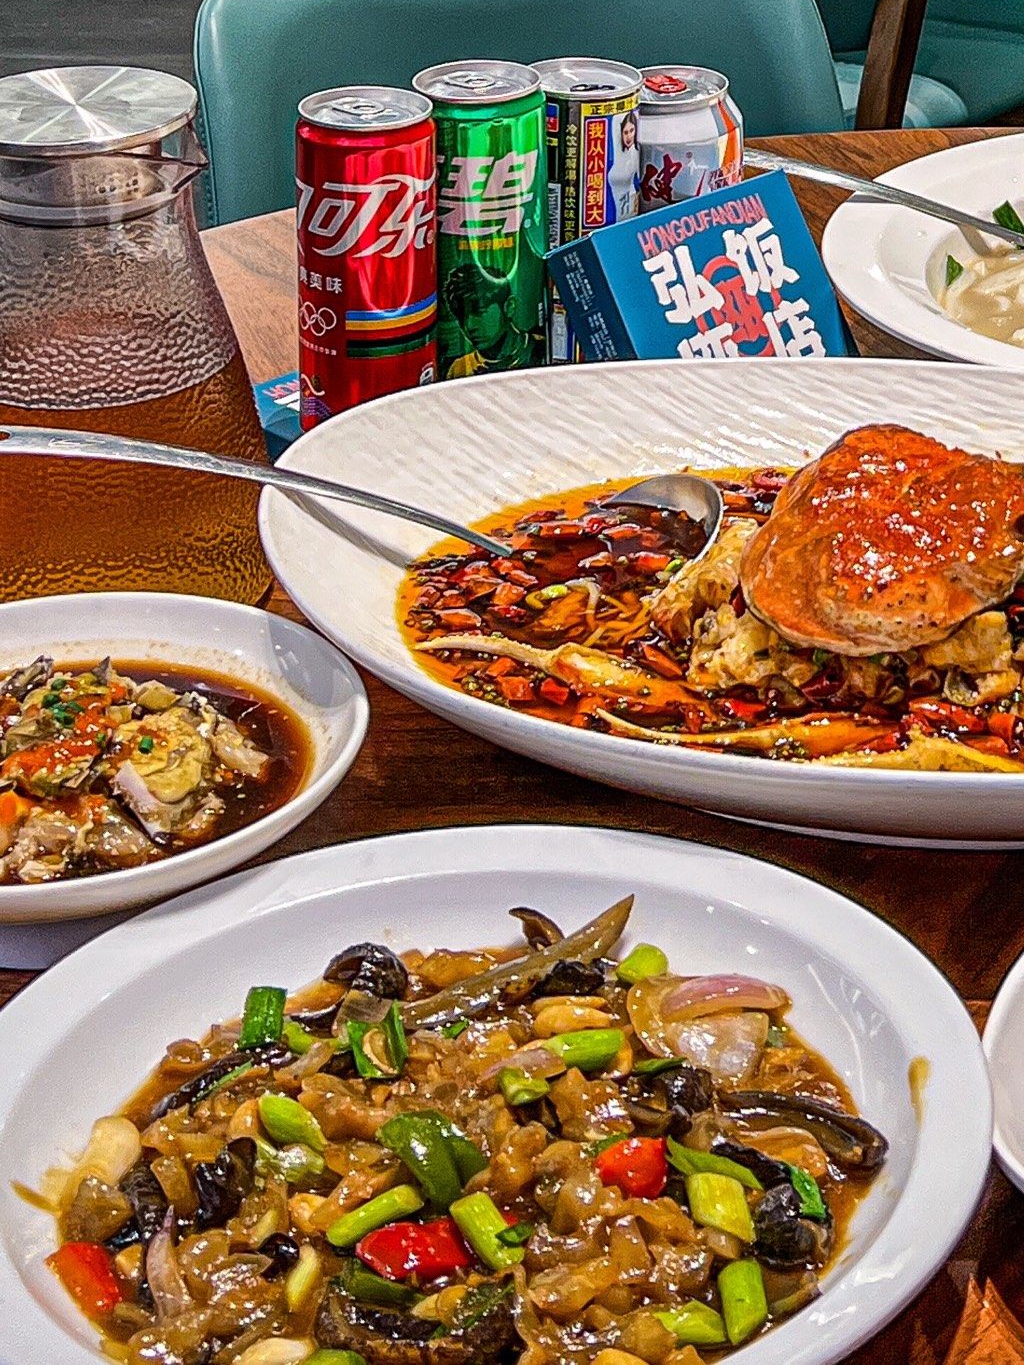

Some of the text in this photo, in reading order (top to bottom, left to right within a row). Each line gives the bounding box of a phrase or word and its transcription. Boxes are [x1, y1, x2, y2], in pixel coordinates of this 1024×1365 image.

[437, 149, 538, 235] 碧
[587, 122, 605, 223] 我从小喝到大
[636, 193, 768, 260] HONGOUFANDIAN
